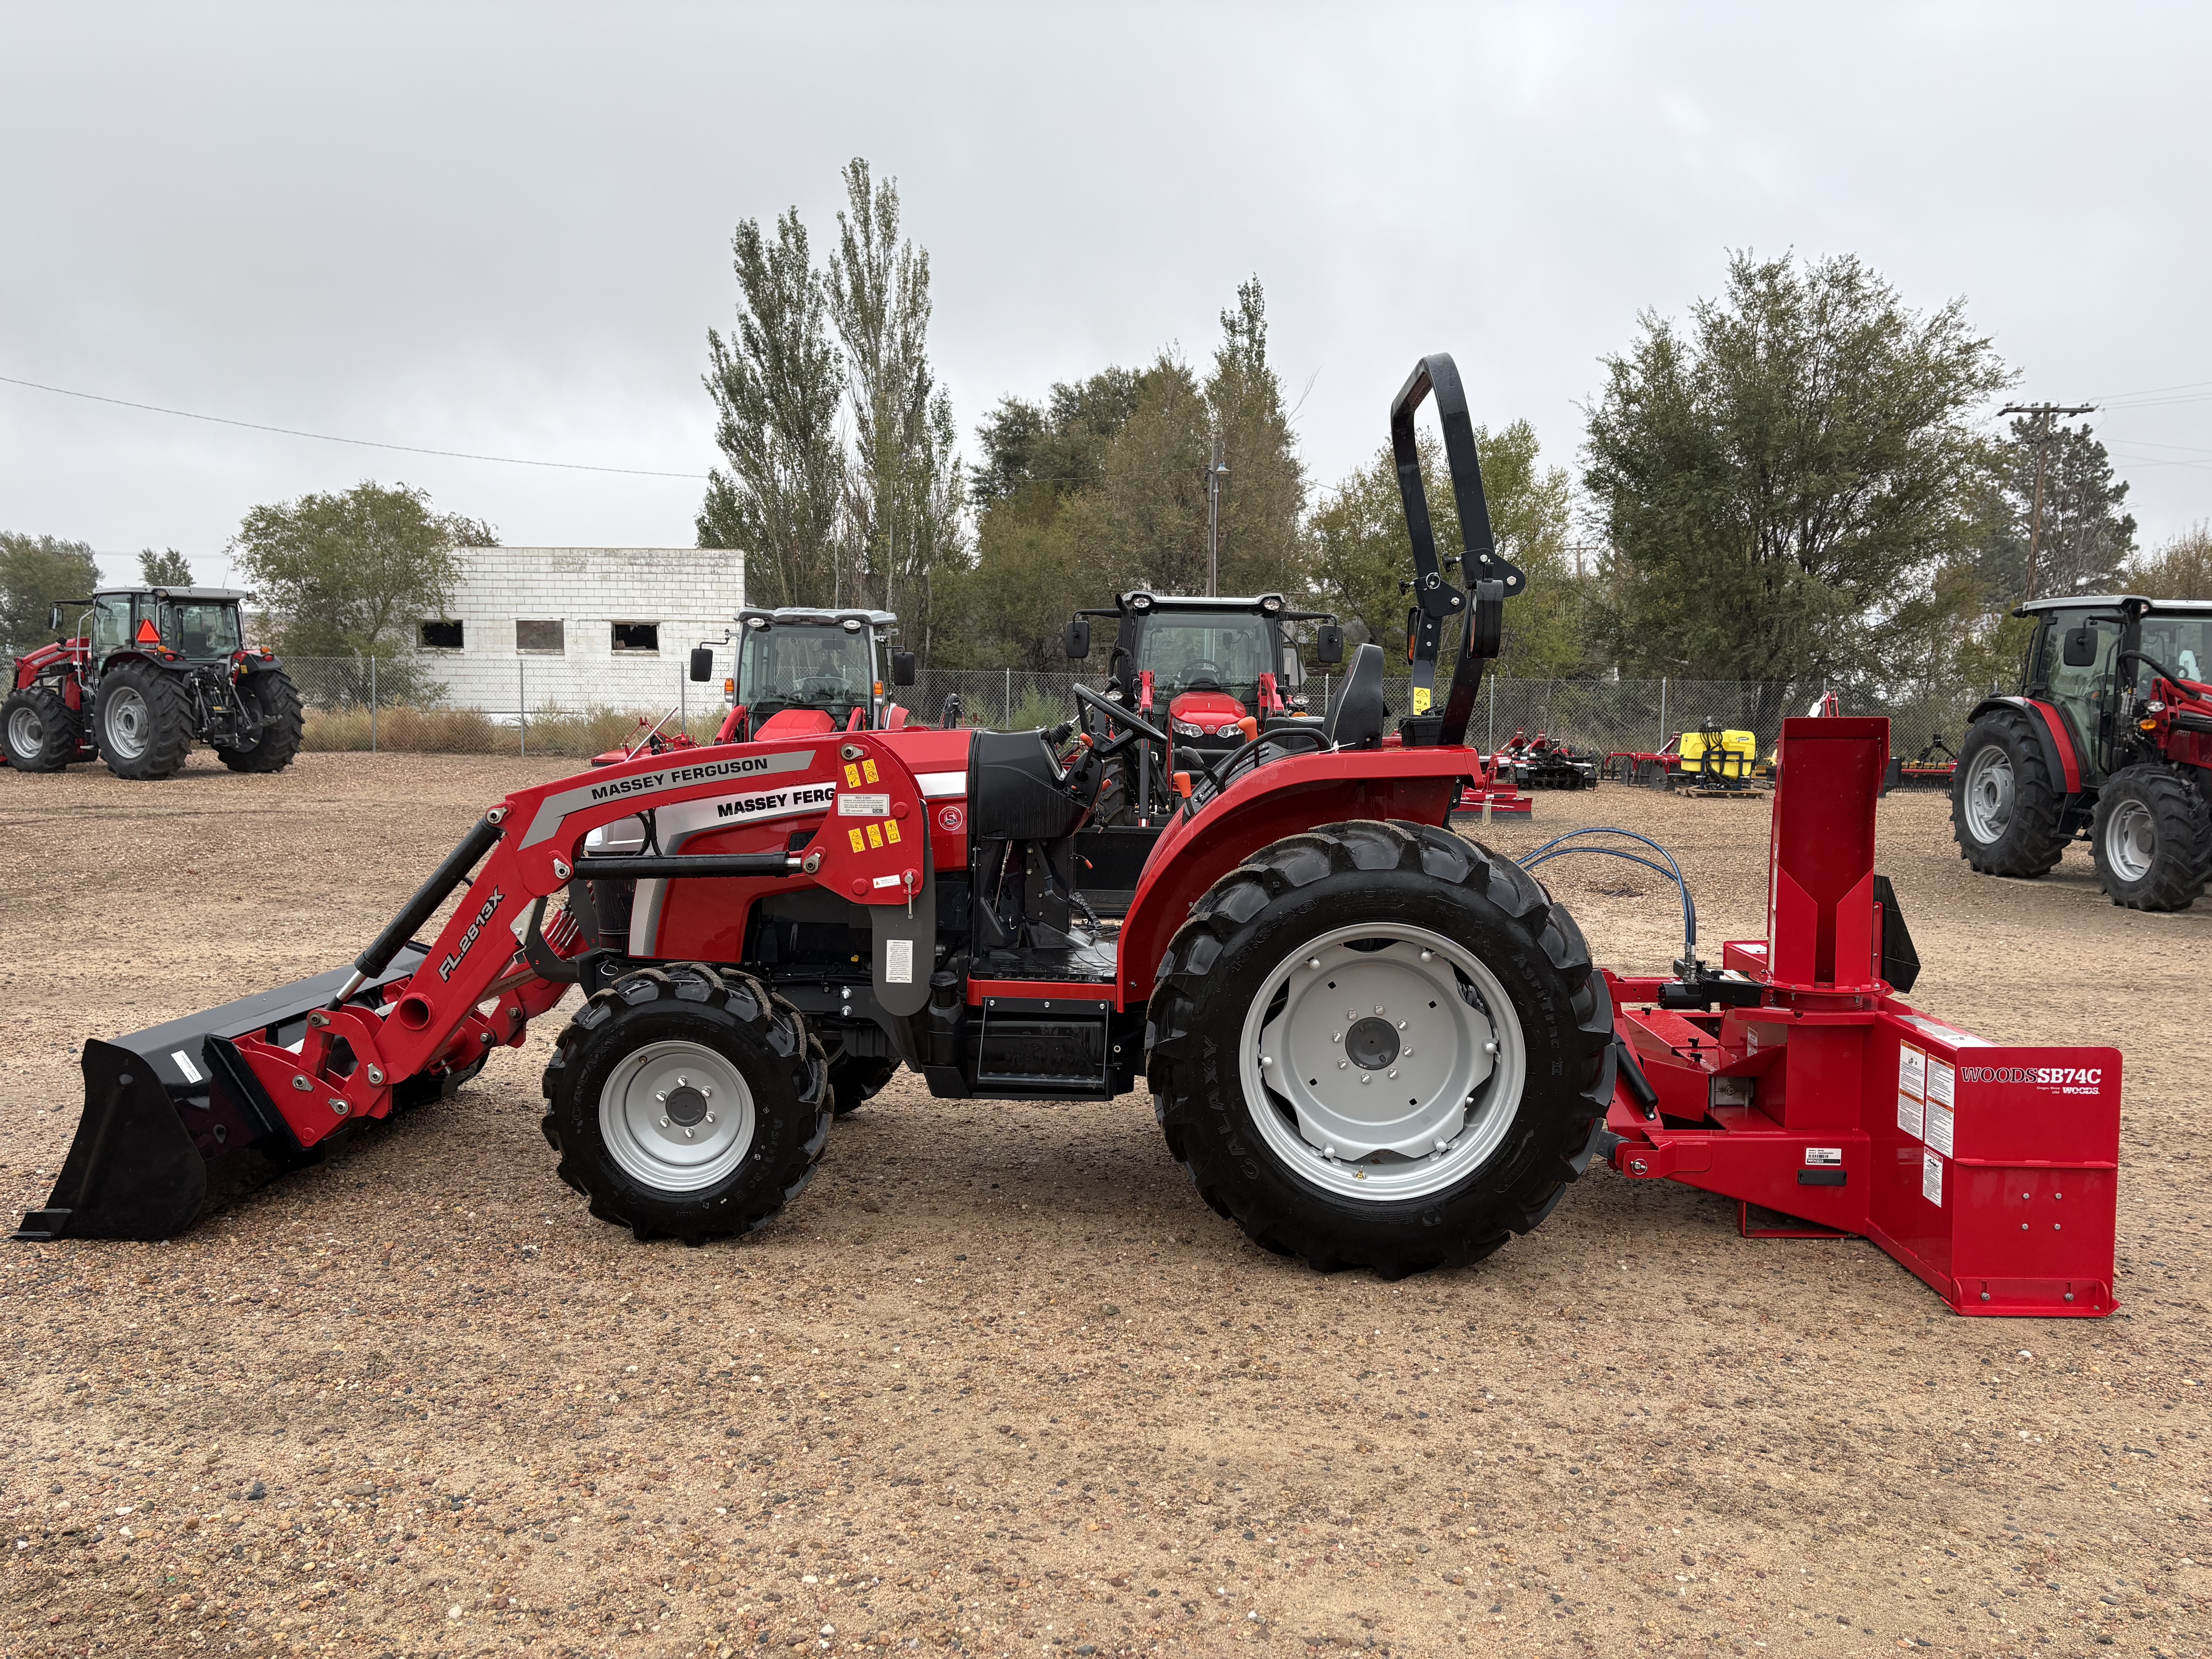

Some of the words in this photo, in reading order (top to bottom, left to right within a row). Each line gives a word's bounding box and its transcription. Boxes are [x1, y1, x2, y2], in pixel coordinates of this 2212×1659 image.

[591, 774, 664, 800] MASSEY
[672, 758, 768, 783] FERGUSON
[717, 793, 787, 817] MASSEY
[793, 788, 836, 805] FERG
[437, 884, 505, 984] FL.2813X
[1231, 900, 1317, 971] 13.6-28
[1511, 953, 1559, 1048] AgriTrac
[1202, 1034, 1261, 1180] GALAXY
